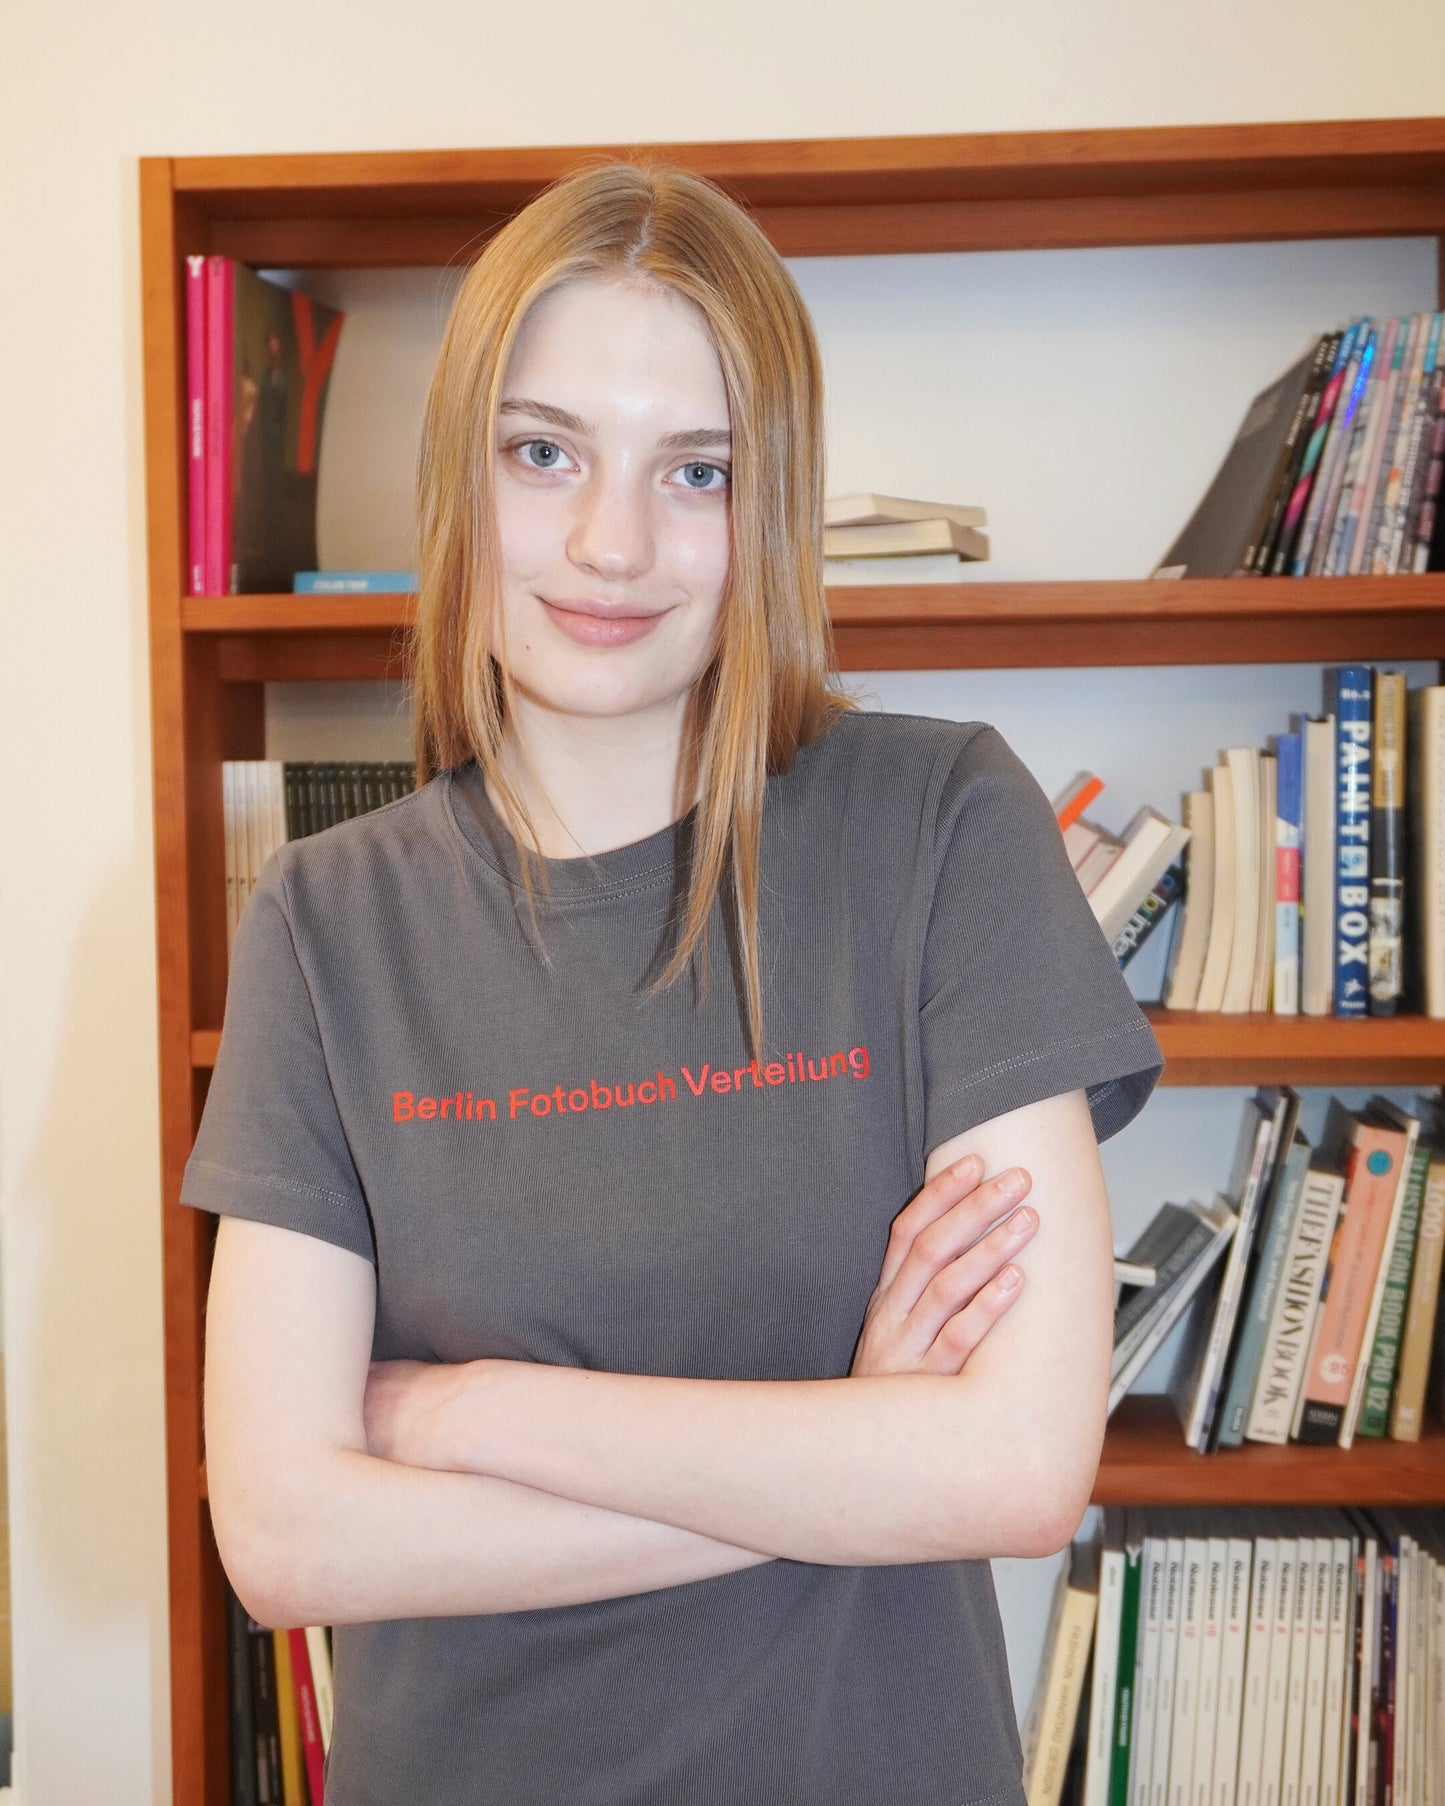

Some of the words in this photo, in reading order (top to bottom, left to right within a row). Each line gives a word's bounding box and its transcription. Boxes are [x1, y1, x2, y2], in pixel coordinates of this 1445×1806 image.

[393, 1091, 497, 1123] Berlin
[509, 1071, 677, 1119] Fotobuch
[681, 1046, 871, 1097] Verteilung
[1371, 1343, 1396, 1383] PRO
